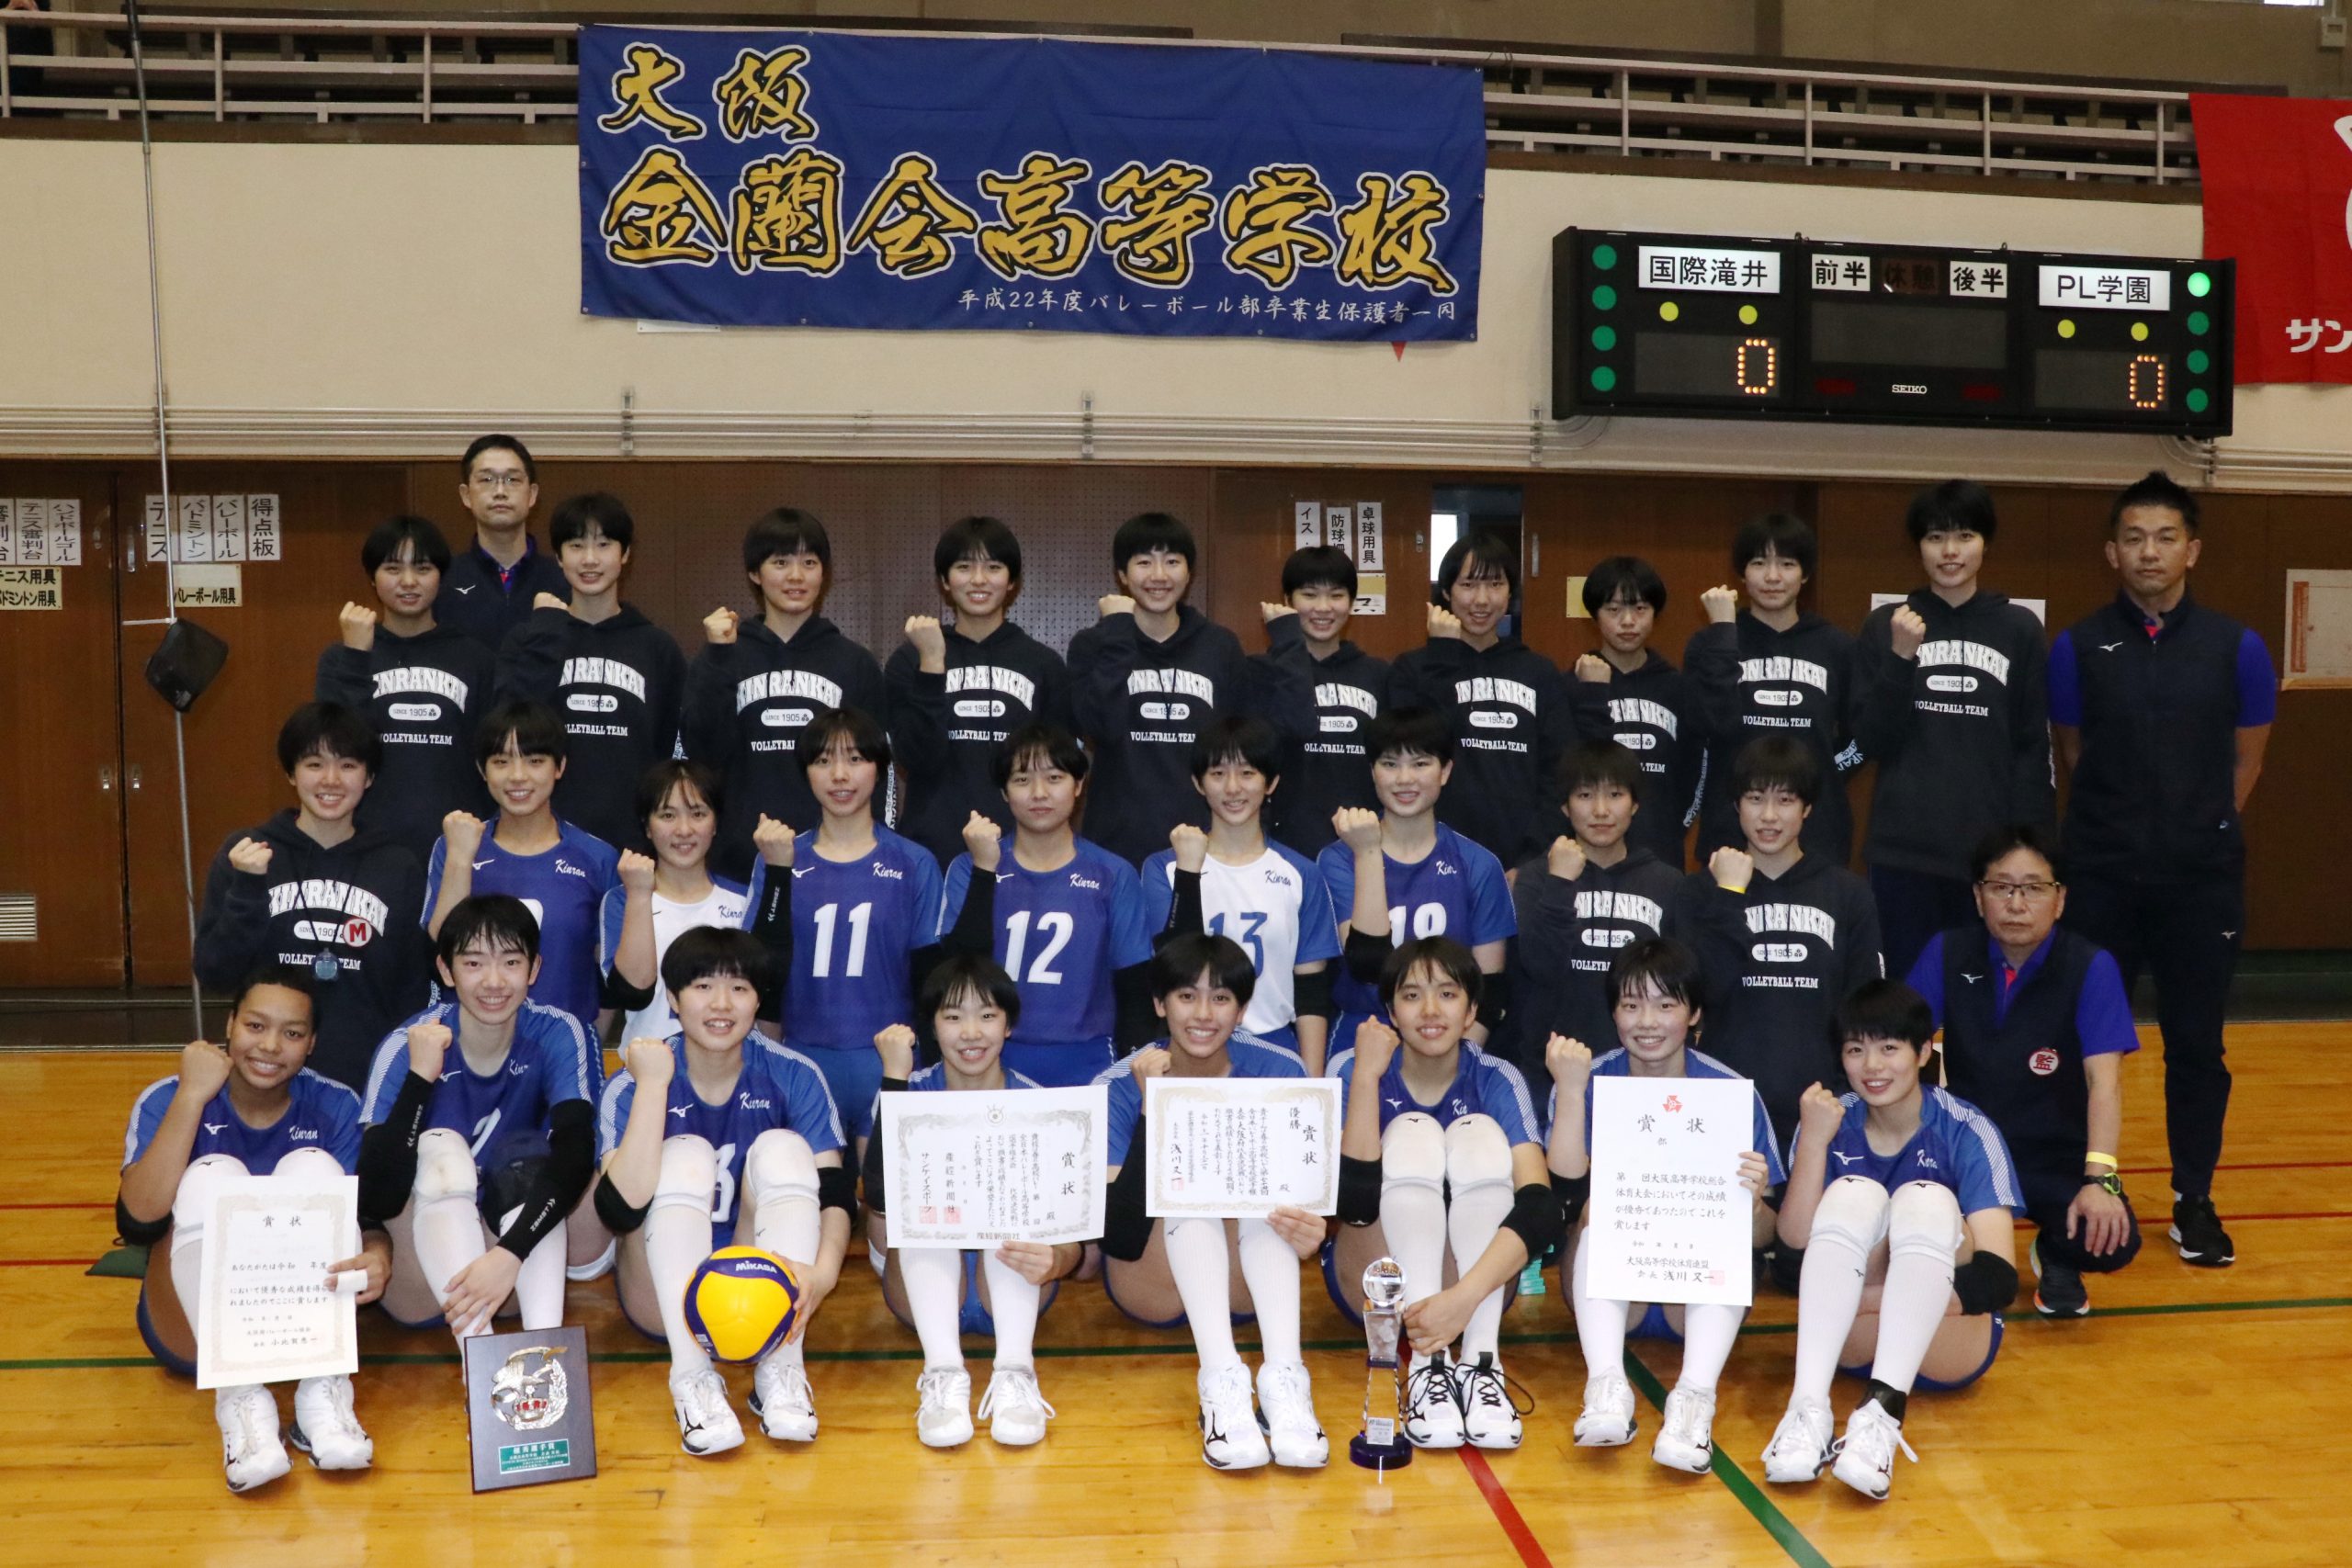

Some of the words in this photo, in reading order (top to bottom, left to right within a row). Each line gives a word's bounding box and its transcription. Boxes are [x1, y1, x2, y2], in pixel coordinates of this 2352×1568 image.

[598, 42, 812, 143] 大阪
[605, 145, 1460, 295] 金蘭会高等学校
[1647, 254, 1770, 288] 国際滝井
[1815, 258, 1868, 287] 前半
[1953, 266, 2005, 293] 後半
[2056, 274, 2153, 306] PL学園
[957, 288, 1455, 324] 平成22年度バレーボール部卒業生保護者一同
[1737, 338, 1775, 395] 0
[1892, 384, 1928, 395] SEIKO
[2129, 355, 2165, 409] 0
[149, 502, 172, 558] テニス
[216, 499, 239, 558] バレーボール
[251, 498, 275, 557] 得点板
[1362, 507, 1376, 564] 卓球用具
[410, 708, 427, 716] 1905
[782, 714, 799, 722] 1905
[1965, 705, 1988, 716] TEAM
[565, 724, 605, 735] LLEYBALL
[606, 726, 628, 736] TEAM
[1743, 716, 1789, 727] VOLLEYBALL
[1791, 717, 1812, 728] TEAM
[382, 733, 428, 744] OLLEYBALL
[430, 735, 452, 745] TEAM
[993, 731, 1010, 741] TEA
[1130, 731, 1177, 742] VOLLEYBALL
[1507, 741, 1527, 752] TEAM
[1645, 762, 1666, 773] TEAM
[555, 858, 586, 878] Kinran
[873, 862, 903, 880] Kinran
[1264, 869, 1292, 886] Kinran
[1069, 873, 1100, 890] Kinran
[348, 922, 367, 942] M
[812, 902, 872, 977] 11
[1004, 910, 1074, 985] 12
[278, 953, 316, 965] VOLLEY
[1742, 976, 1793, 987] VOLLEYBALL
[1794, 977, 1818, 988] TEAM
[2033, 1054, 2055, 1071] 監
[1289, 1107, 1302, 1130] 優勝
[1302, 1124, 1318, 1166] 賞状
[922, 1152, 933, 1213] サンケイスポーツ
[1061, 1151, 1075, 1195] 賞状
[1614, 1219, 1651, 1231] 賞します
